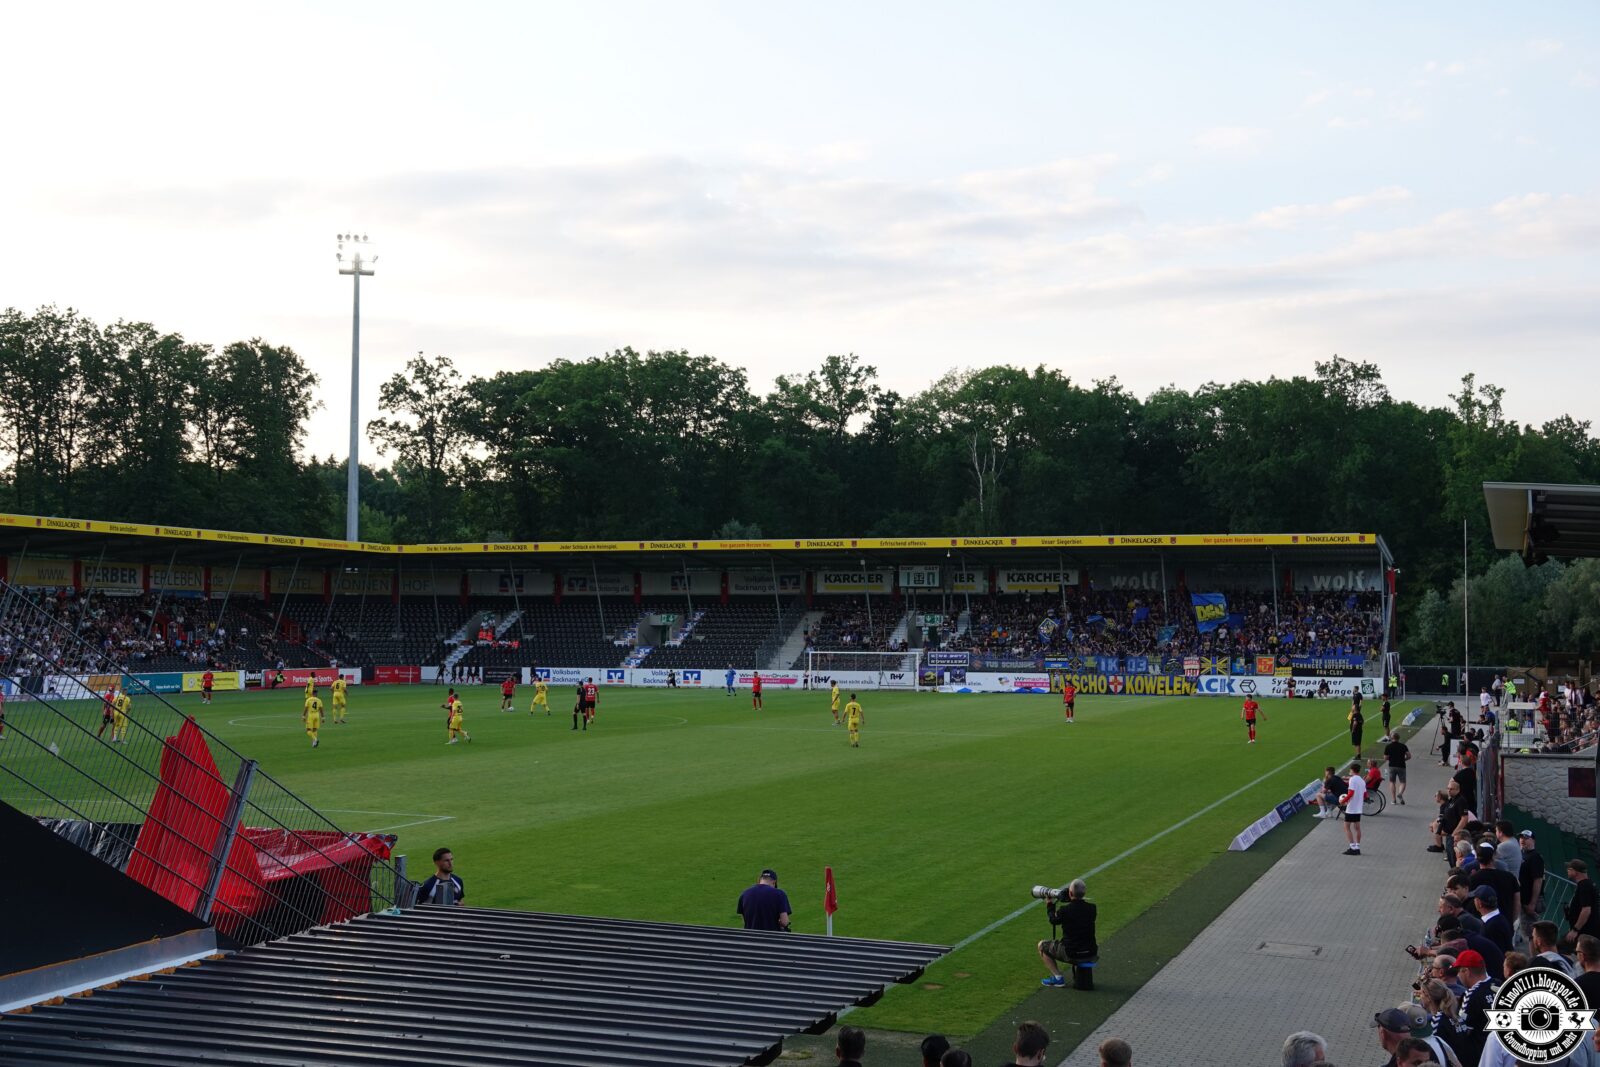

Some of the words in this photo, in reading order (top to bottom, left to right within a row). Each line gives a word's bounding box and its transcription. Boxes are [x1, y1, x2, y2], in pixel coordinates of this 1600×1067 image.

[46, 519, 80, 529] DINKELACKER
[164, 528, 192, 536] DINKELACKER
[272, 536, 296, 544] DINKELACKER
[84, 566, 136, 584] FERBER
[824, 574, 884, 584] KÄRCHER
[1006, 572, 1070, 582] KÄRCHER
[1110, 571, 1160, 590] wolf
[1312, 570, 1364, 590] wolf
[278, 578, 312, 590] HOTEL
[402, 580, 430, 591] HOF
[1100, 658, 1120, 672] IK
[1128, 658, 1148, 672] 03
[246, 671, 261, 680] bwin
[1125, 676, 1197, 695] KOWELENZ
